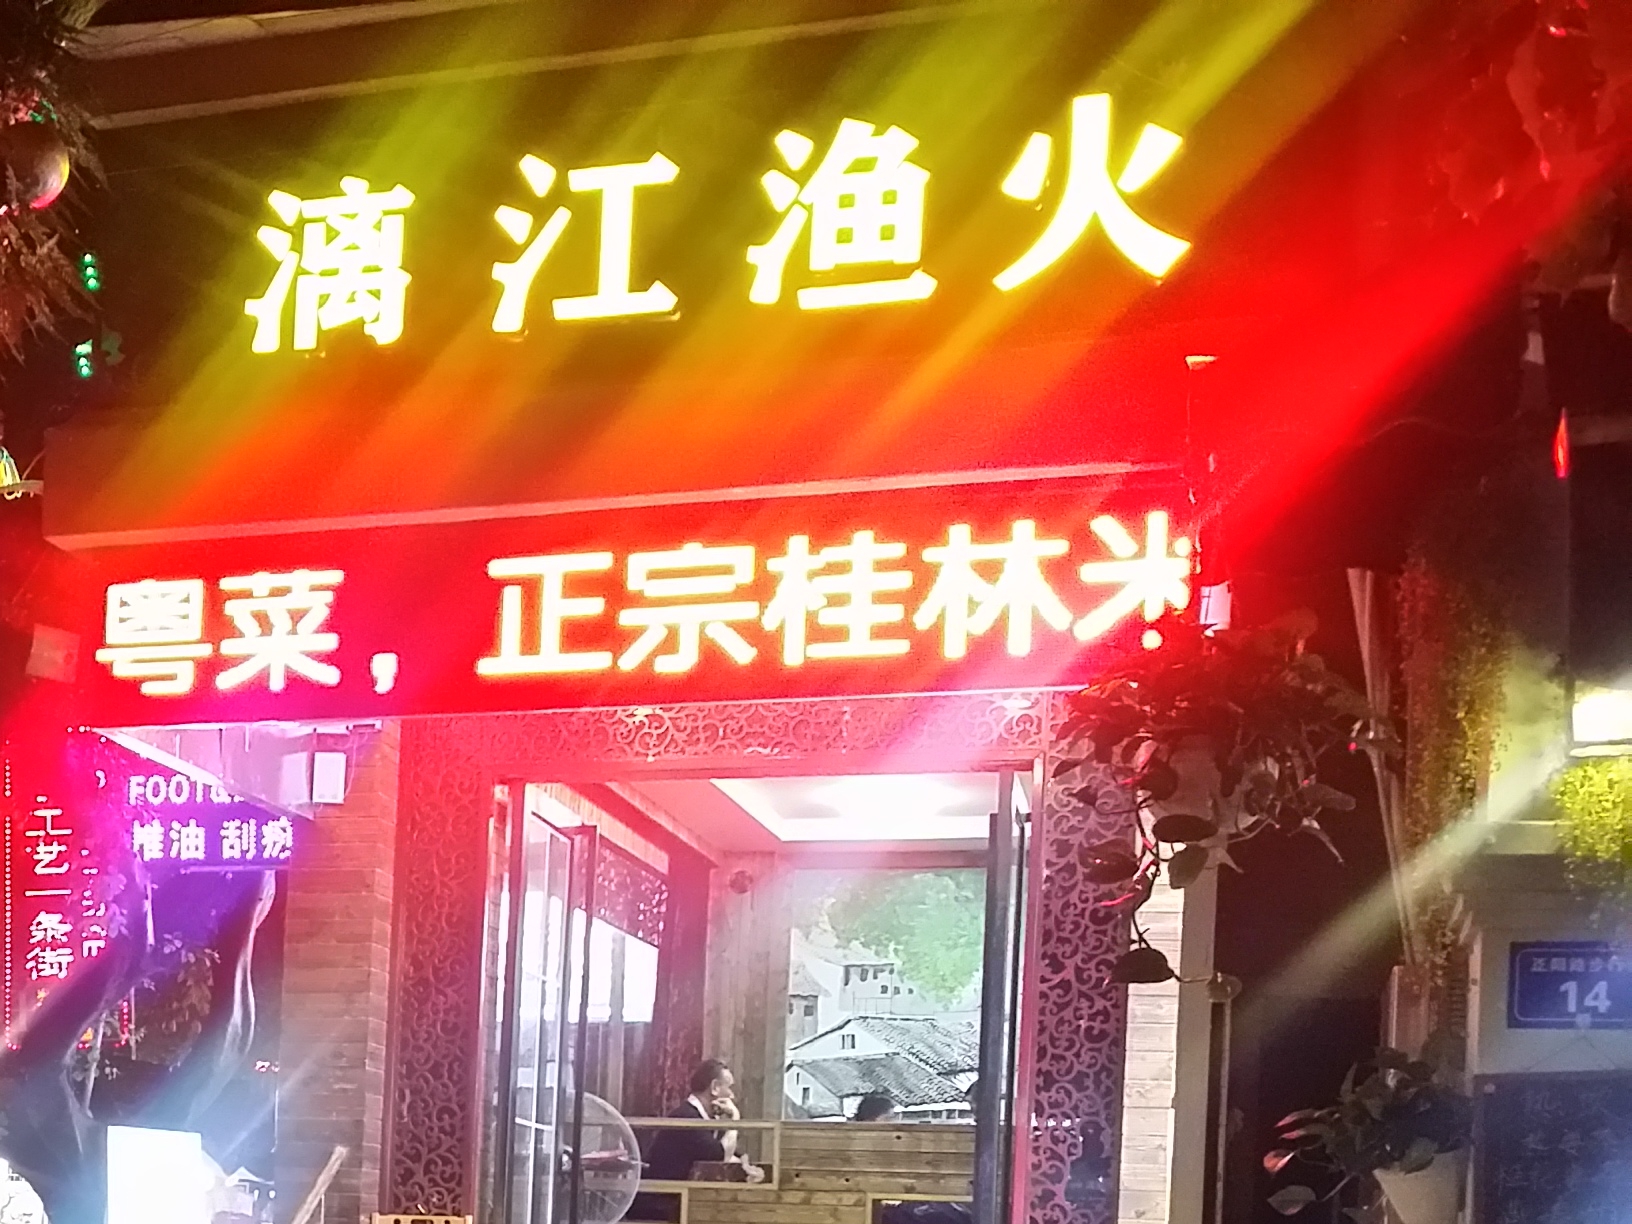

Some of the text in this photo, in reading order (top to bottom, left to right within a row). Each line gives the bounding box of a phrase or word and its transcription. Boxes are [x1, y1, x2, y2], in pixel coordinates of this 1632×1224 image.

[244, 92, 1192, 354] 漓江渔火
[24, 808, 74, 979] 工艺一条街
[1559, 980, 1612, 1013] 14
